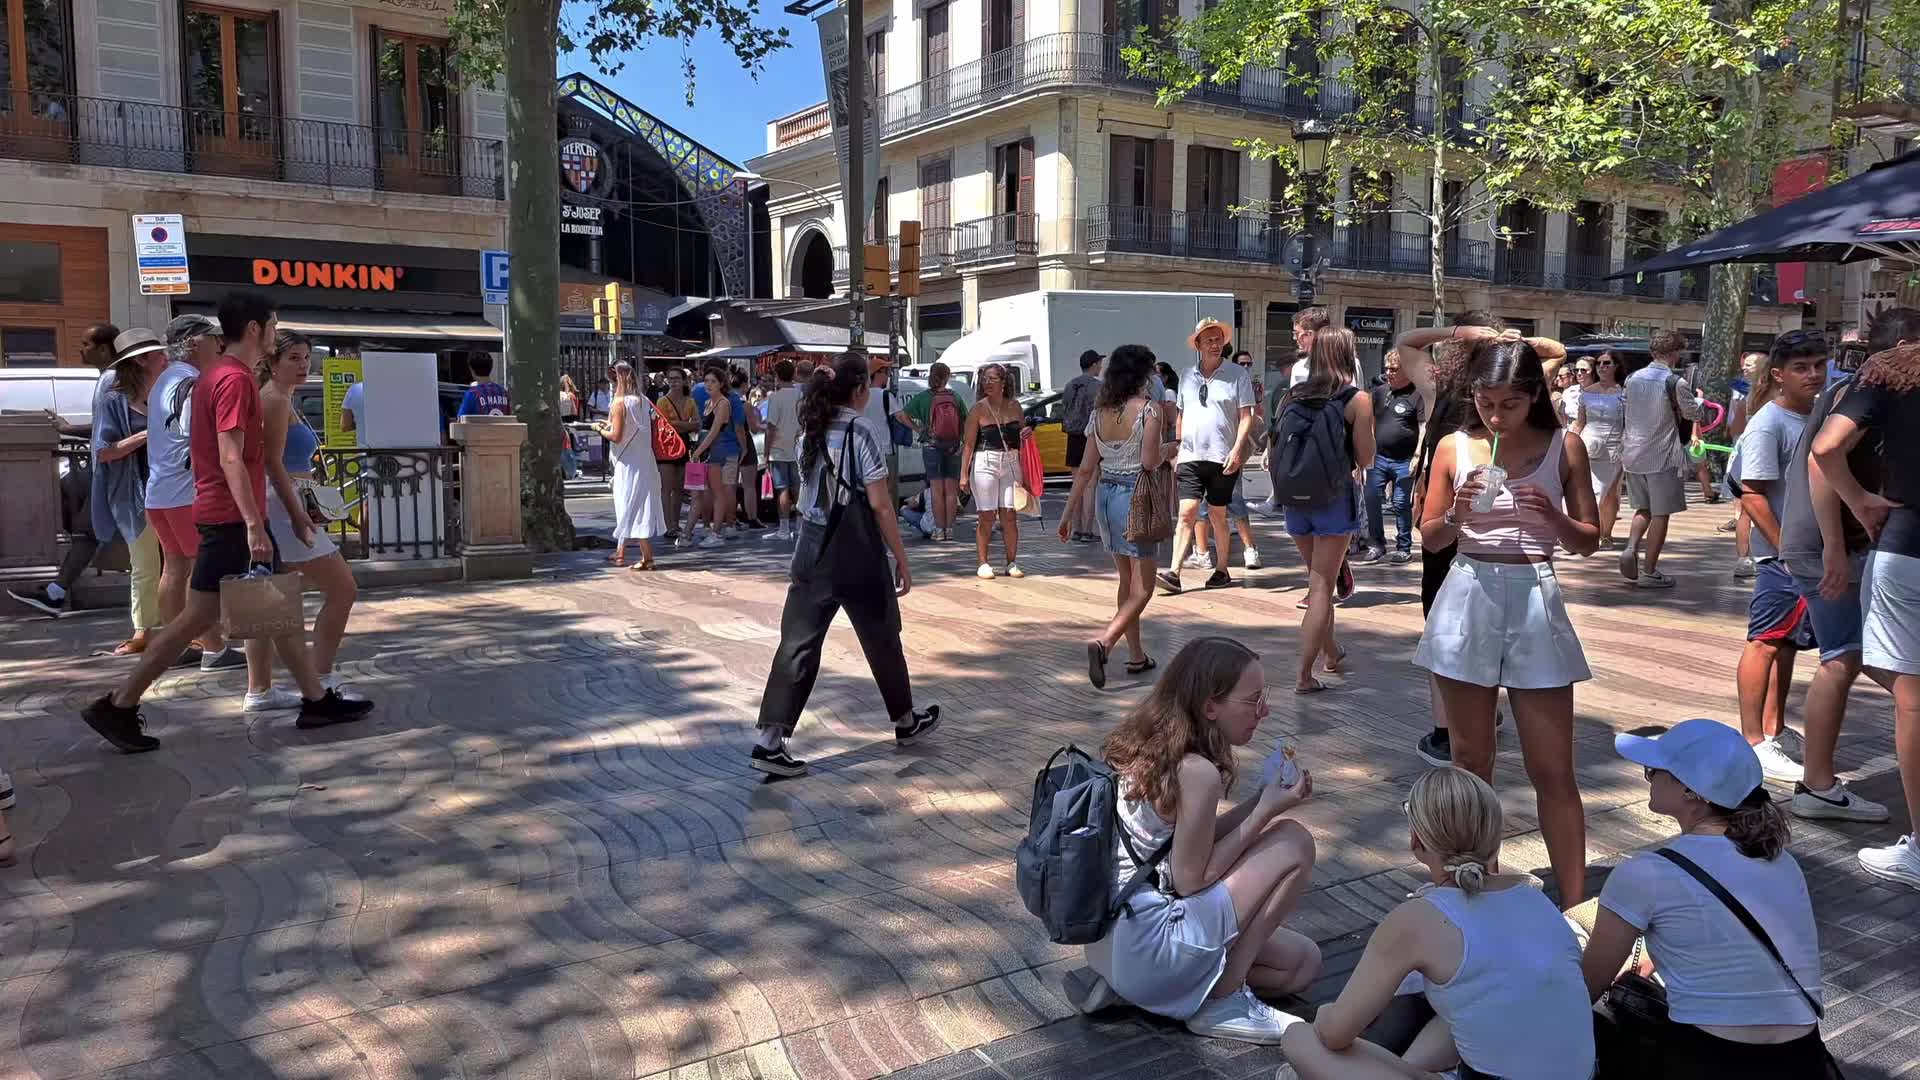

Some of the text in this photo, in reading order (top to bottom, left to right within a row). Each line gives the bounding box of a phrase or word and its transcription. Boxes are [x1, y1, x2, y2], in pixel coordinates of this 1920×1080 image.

[563, 142, 598, 157] MERCAT
[571, 206, 601, 220] JOSEP
[561, 223, 603, 236] LA BOQUERIA
[492, 256, 509, 287] P
